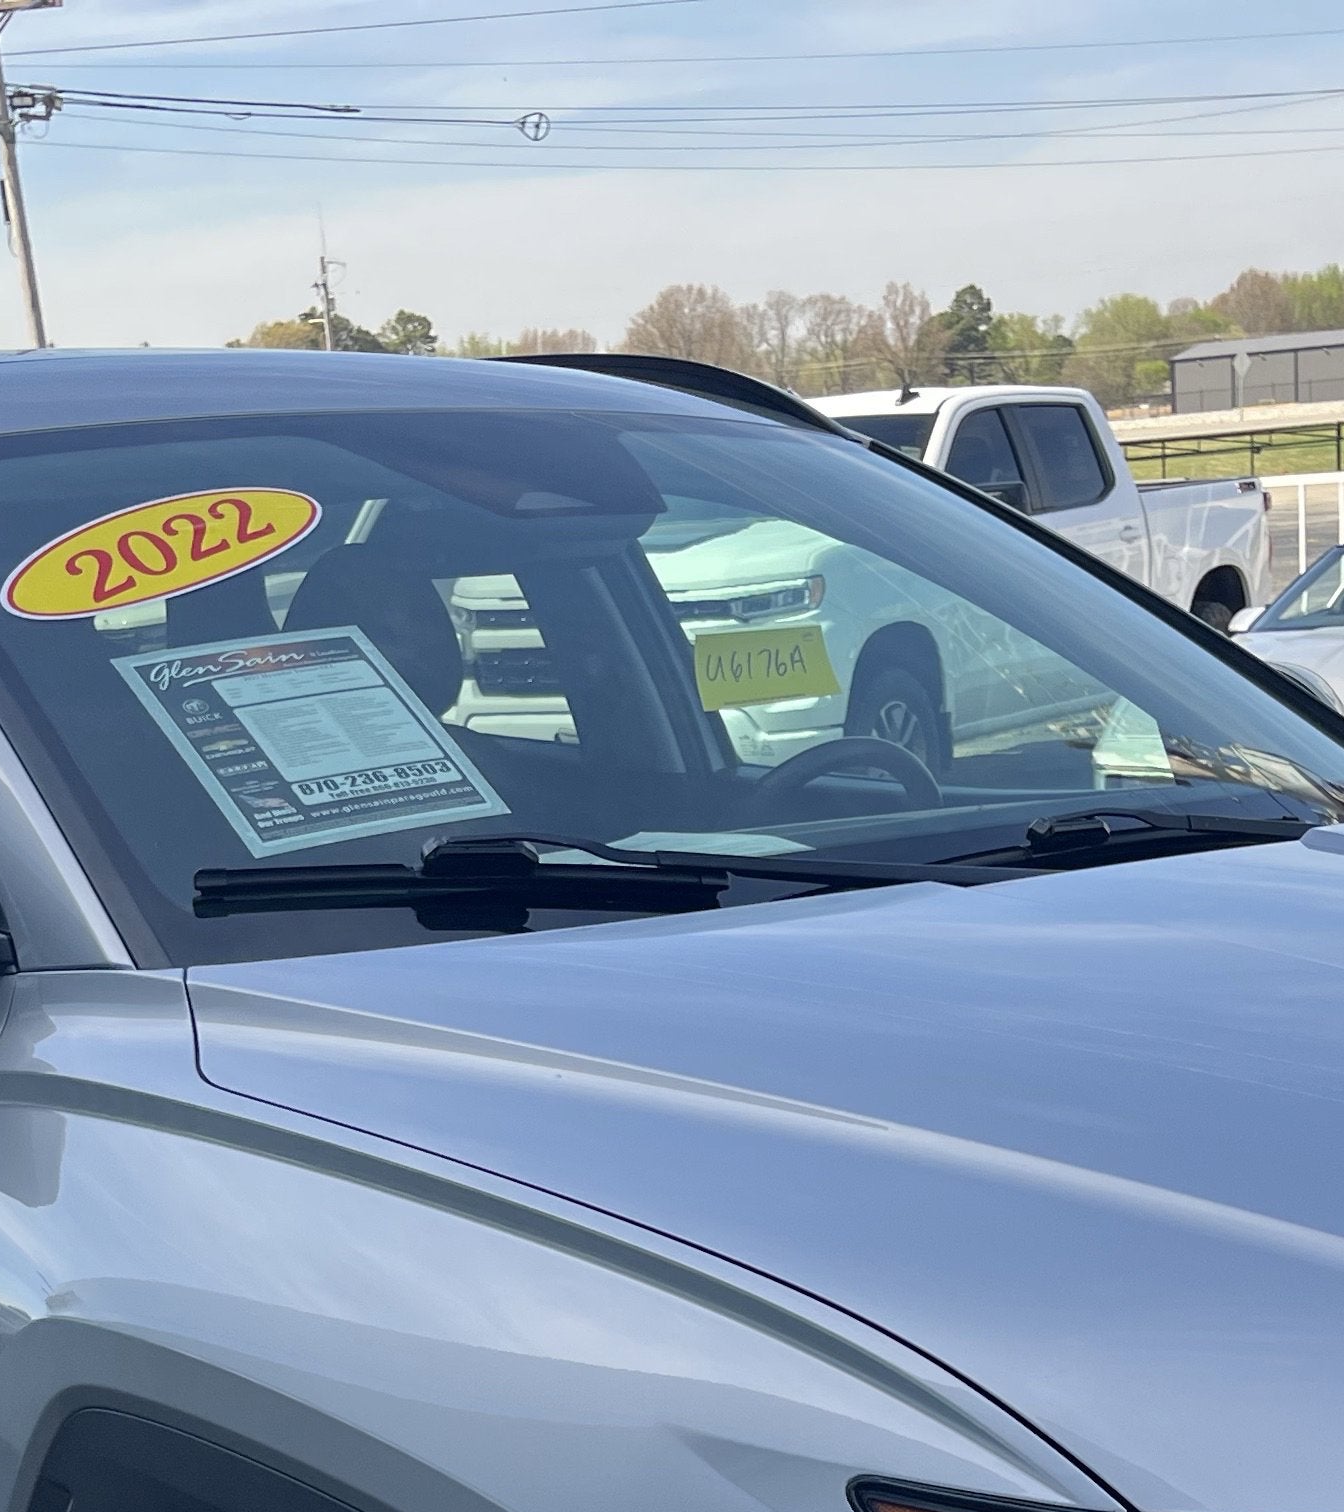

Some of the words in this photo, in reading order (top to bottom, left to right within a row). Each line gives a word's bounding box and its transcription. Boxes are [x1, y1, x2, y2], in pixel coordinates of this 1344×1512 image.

[65, 498, 277, 603] 2022
[150, 660, 222, 690] Glen
[217, 650, 305, 673] Sain
[706, 644, 807, 682] U6176A
[186, 712, 223, 725] BUICK
[298, 760, 452, 796] 870-236-8503
